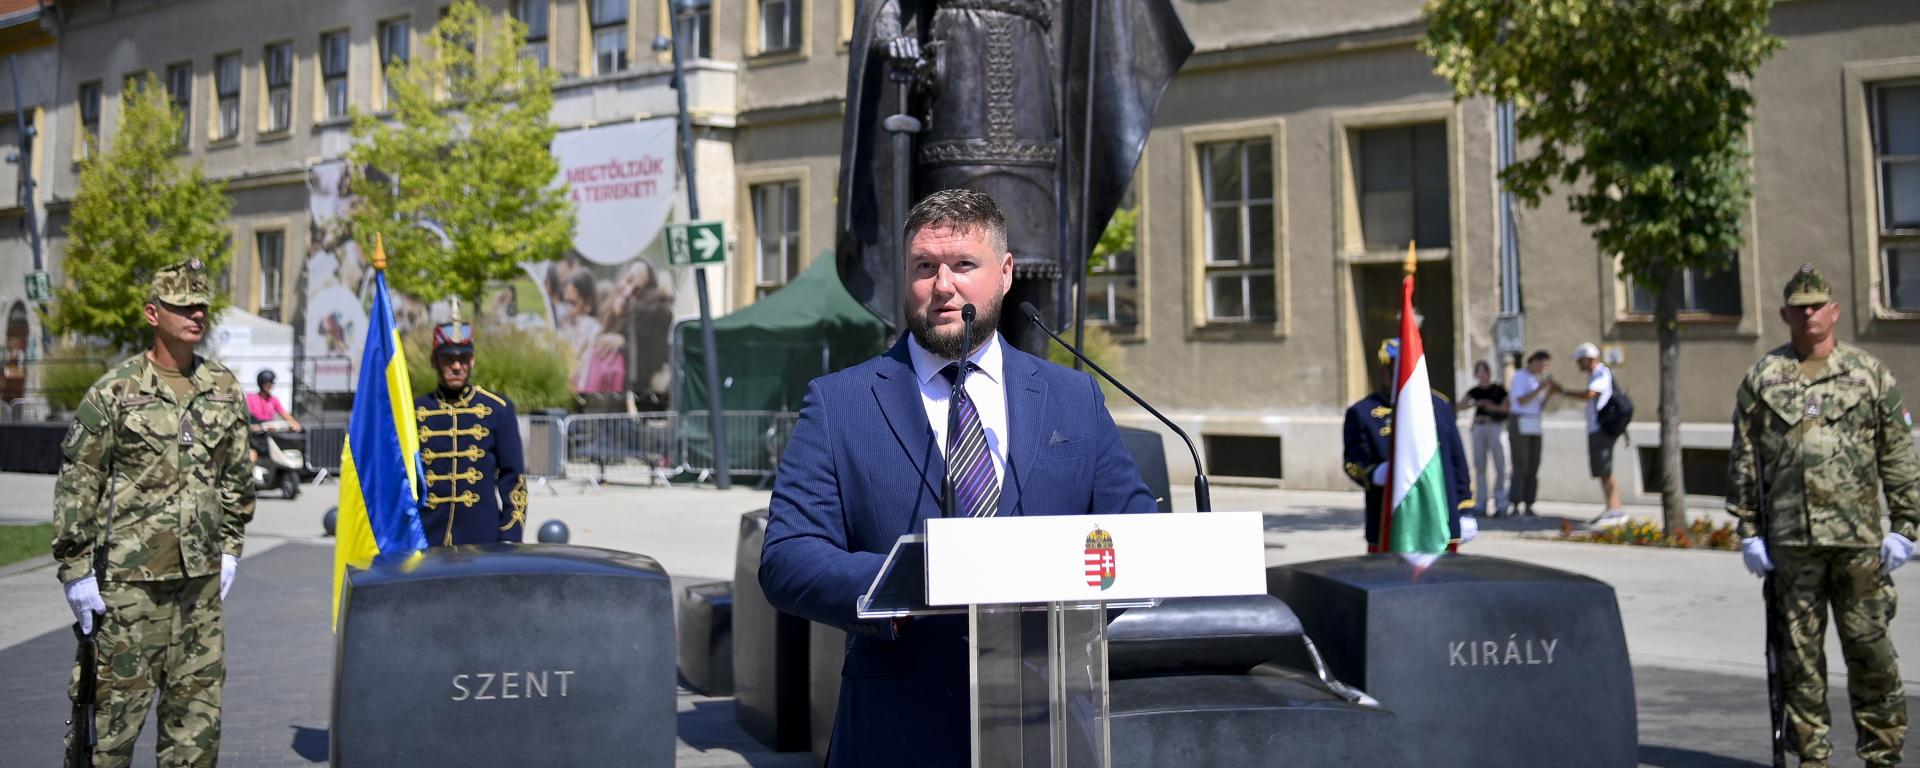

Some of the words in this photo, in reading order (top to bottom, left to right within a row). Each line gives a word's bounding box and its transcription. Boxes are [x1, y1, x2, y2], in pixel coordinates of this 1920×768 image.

[570, 187, 581, 201] A
[585, 180, 657, 202] TEREKET!
[1448, 632, 1559, 667] KIRÁLY
[451, 670, 575, 701] SZENT
